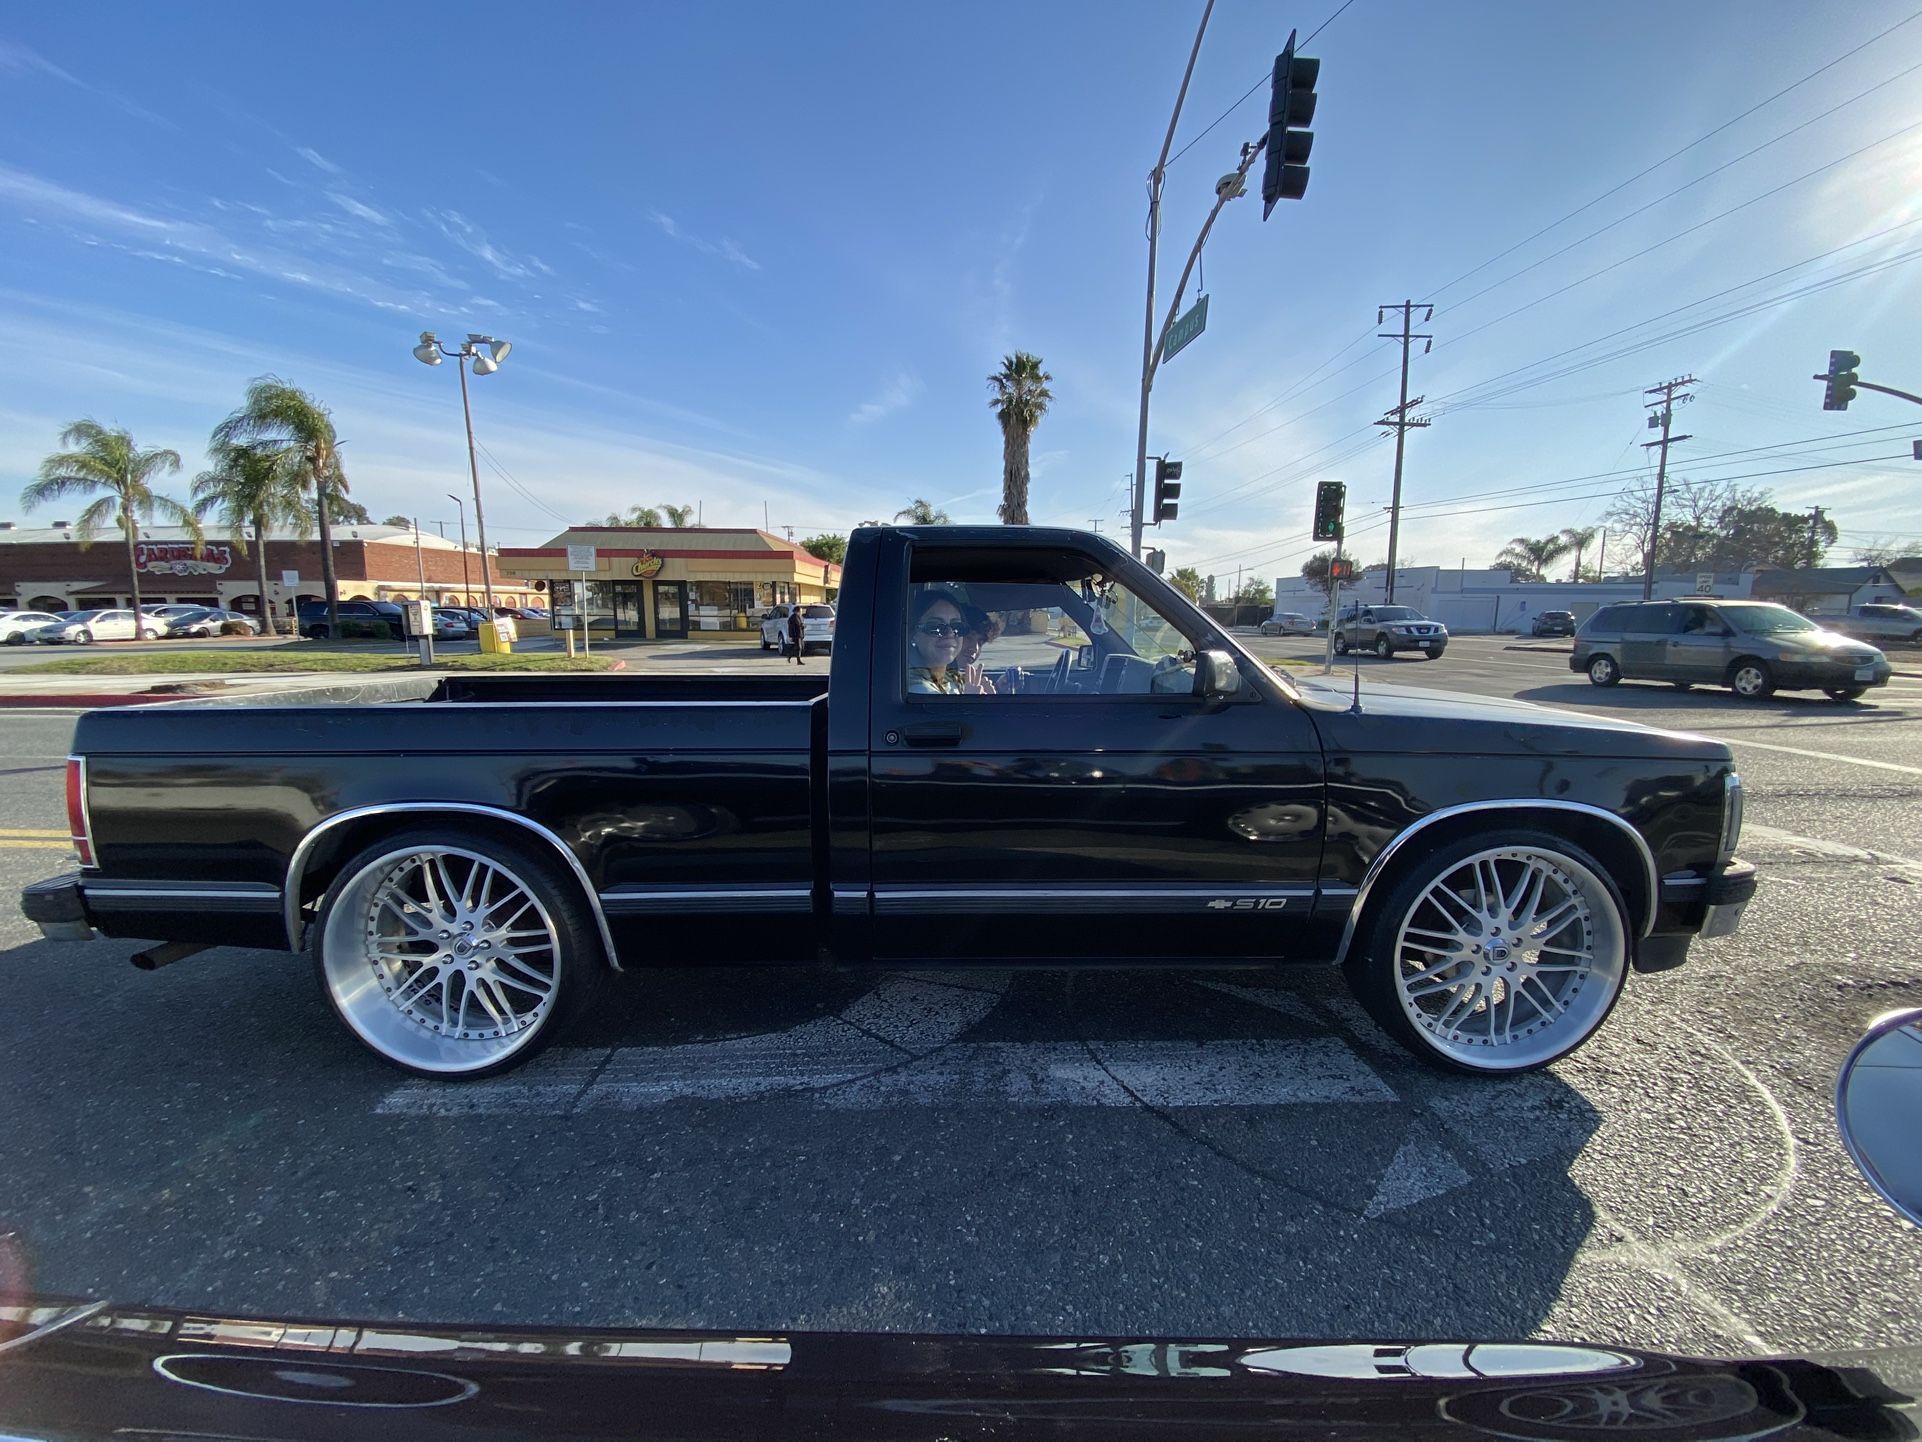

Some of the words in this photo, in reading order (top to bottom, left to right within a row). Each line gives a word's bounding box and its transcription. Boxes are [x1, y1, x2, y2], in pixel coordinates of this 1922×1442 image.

[135, 544, 231, 571] CARDEAS
[1696, 584, 1712, 593] 40
[1233, 898, 1287, 909] S10
